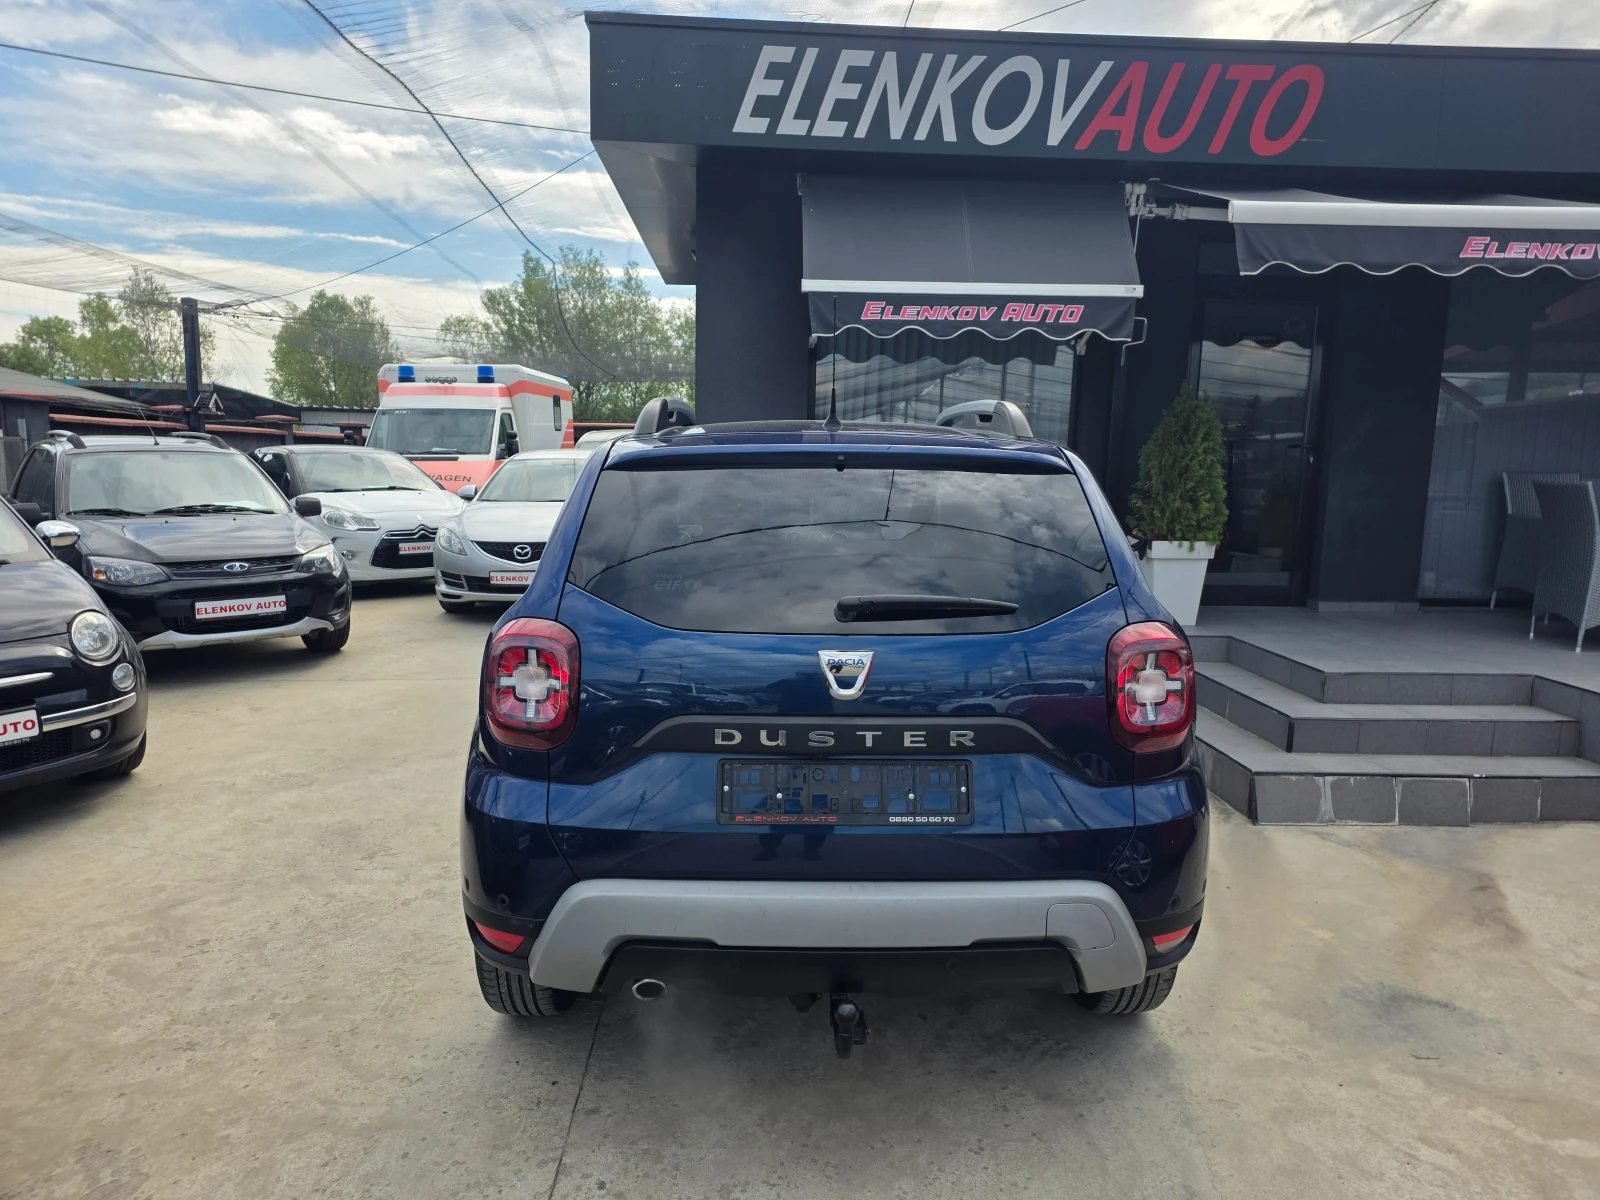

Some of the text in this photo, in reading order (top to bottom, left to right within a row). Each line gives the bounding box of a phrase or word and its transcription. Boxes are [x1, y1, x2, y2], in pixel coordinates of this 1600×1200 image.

[732, 45, 1325, 156] ELENKOV AUTO
[1459, 236, 1600, 260] ELENKO
[1001, 303, 1084, 323] AUTO
[196, 603, 252, 615] ELENKOV
[256, 600, 287, 610] AUTO
[827, 658, 865, 666] DACIA
[0, 719, 36, 736] UTO
